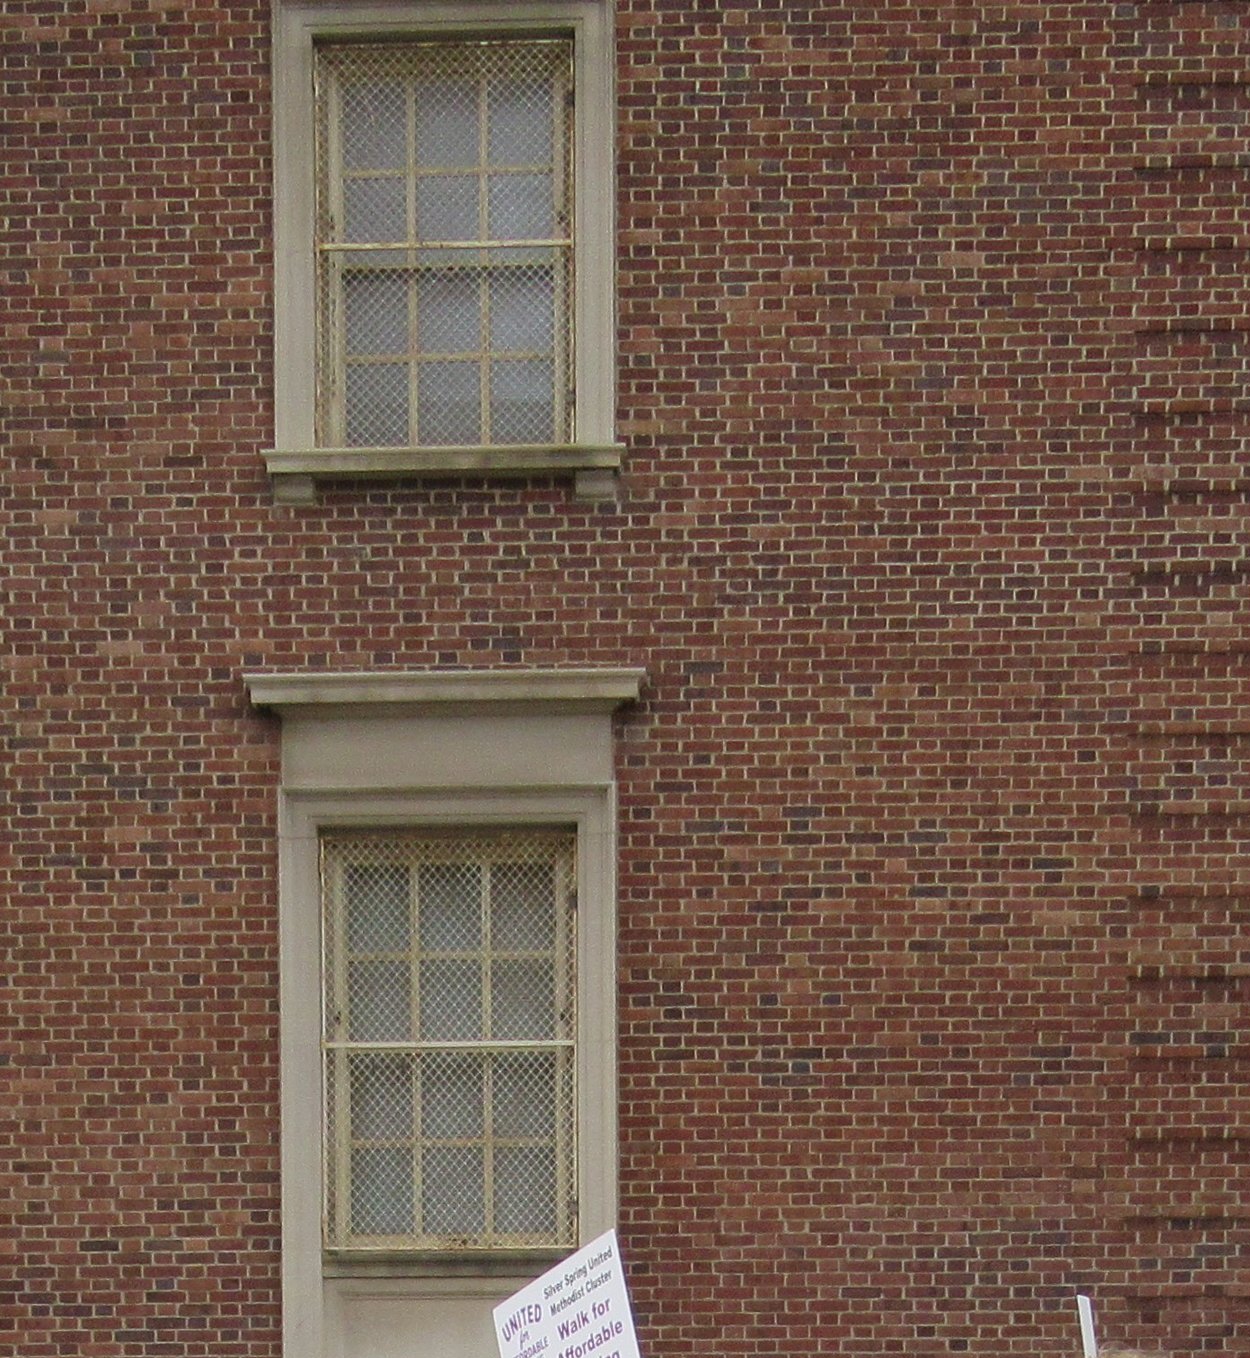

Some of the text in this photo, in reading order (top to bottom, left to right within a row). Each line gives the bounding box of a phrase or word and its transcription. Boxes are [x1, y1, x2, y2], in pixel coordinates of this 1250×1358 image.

[543, 1246, 613, 1300] Silver Spring United
[550, 1270, 612, 1317] Methodist Cluster
[502, 1303, 542, 1343] UNITED
[557, 1298, 611, 1340] Walk for
